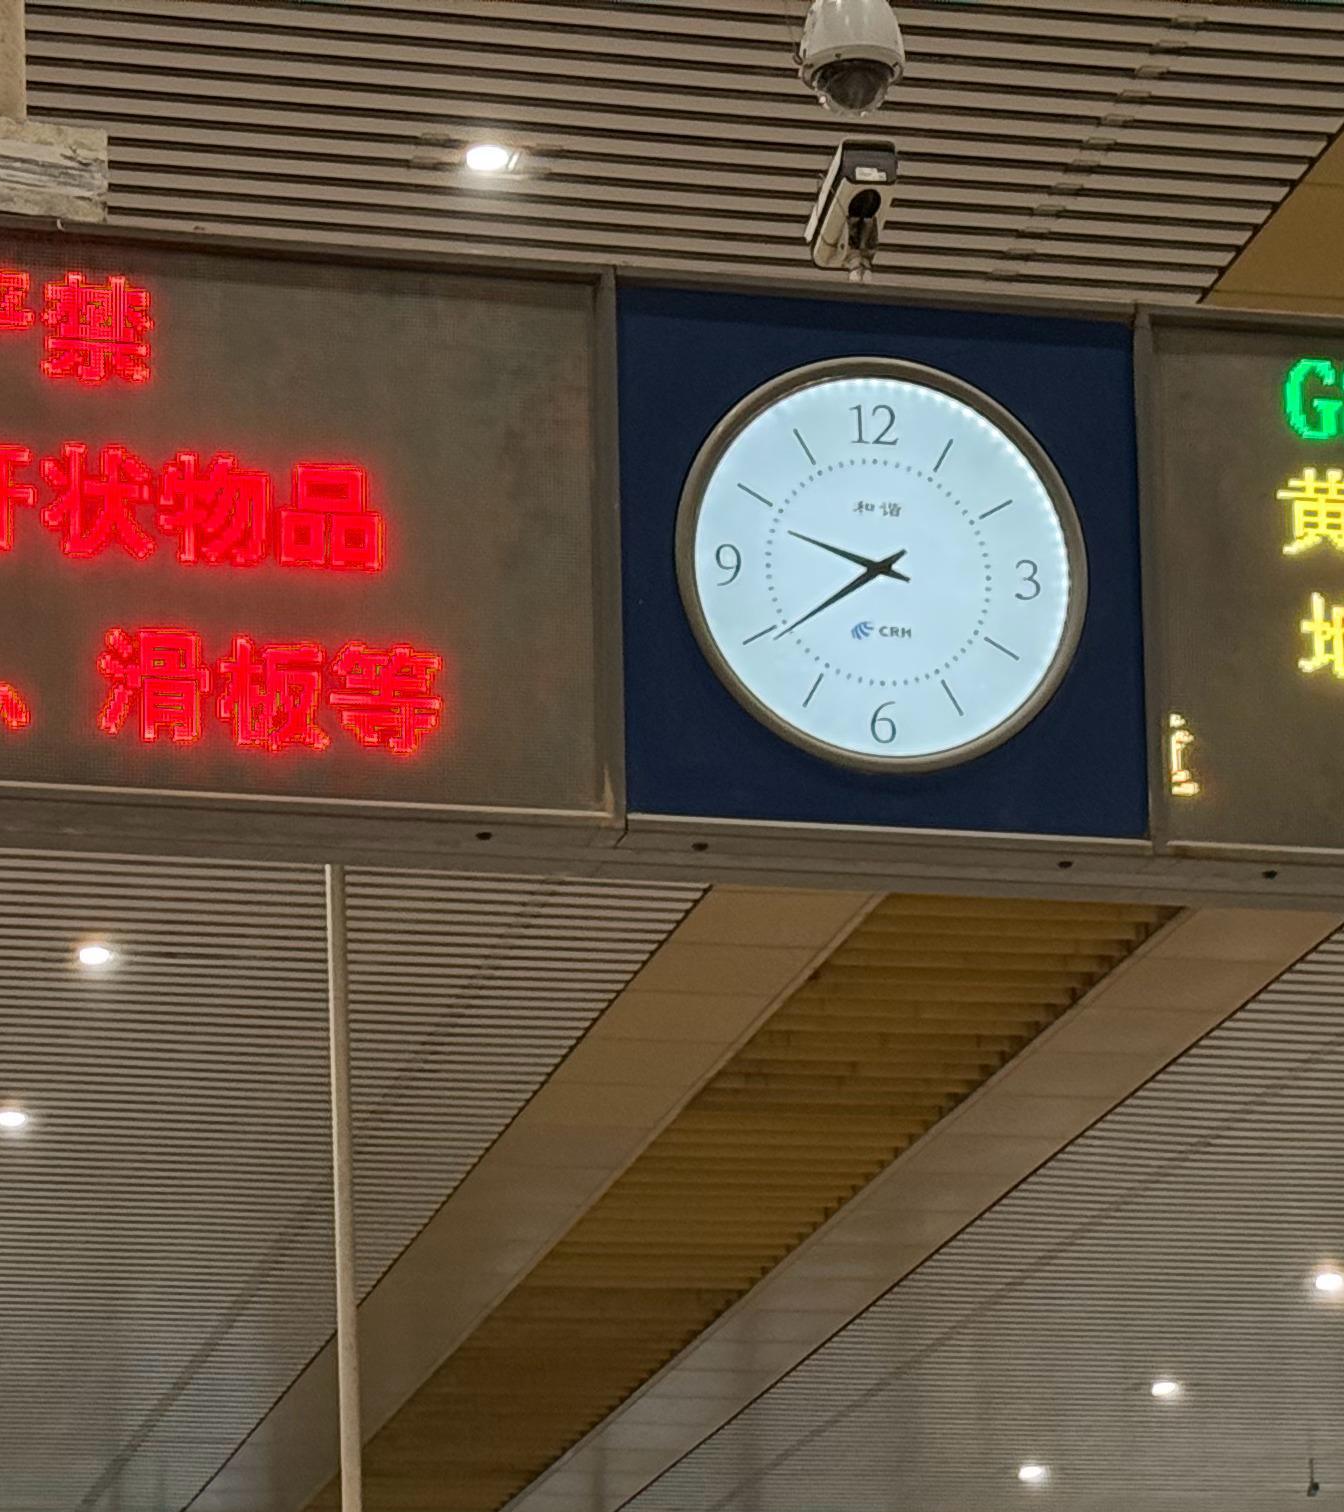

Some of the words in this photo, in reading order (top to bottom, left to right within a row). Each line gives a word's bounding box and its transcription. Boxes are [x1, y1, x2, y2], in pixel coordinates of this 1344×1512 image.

[849, 403, 899, 446] 12
[715, 543, 742, 586] 9
[1014, 559, 1042, 601] 3
[878, 625, 912, 639] CRH
[870, 701, 897, 744] 6
